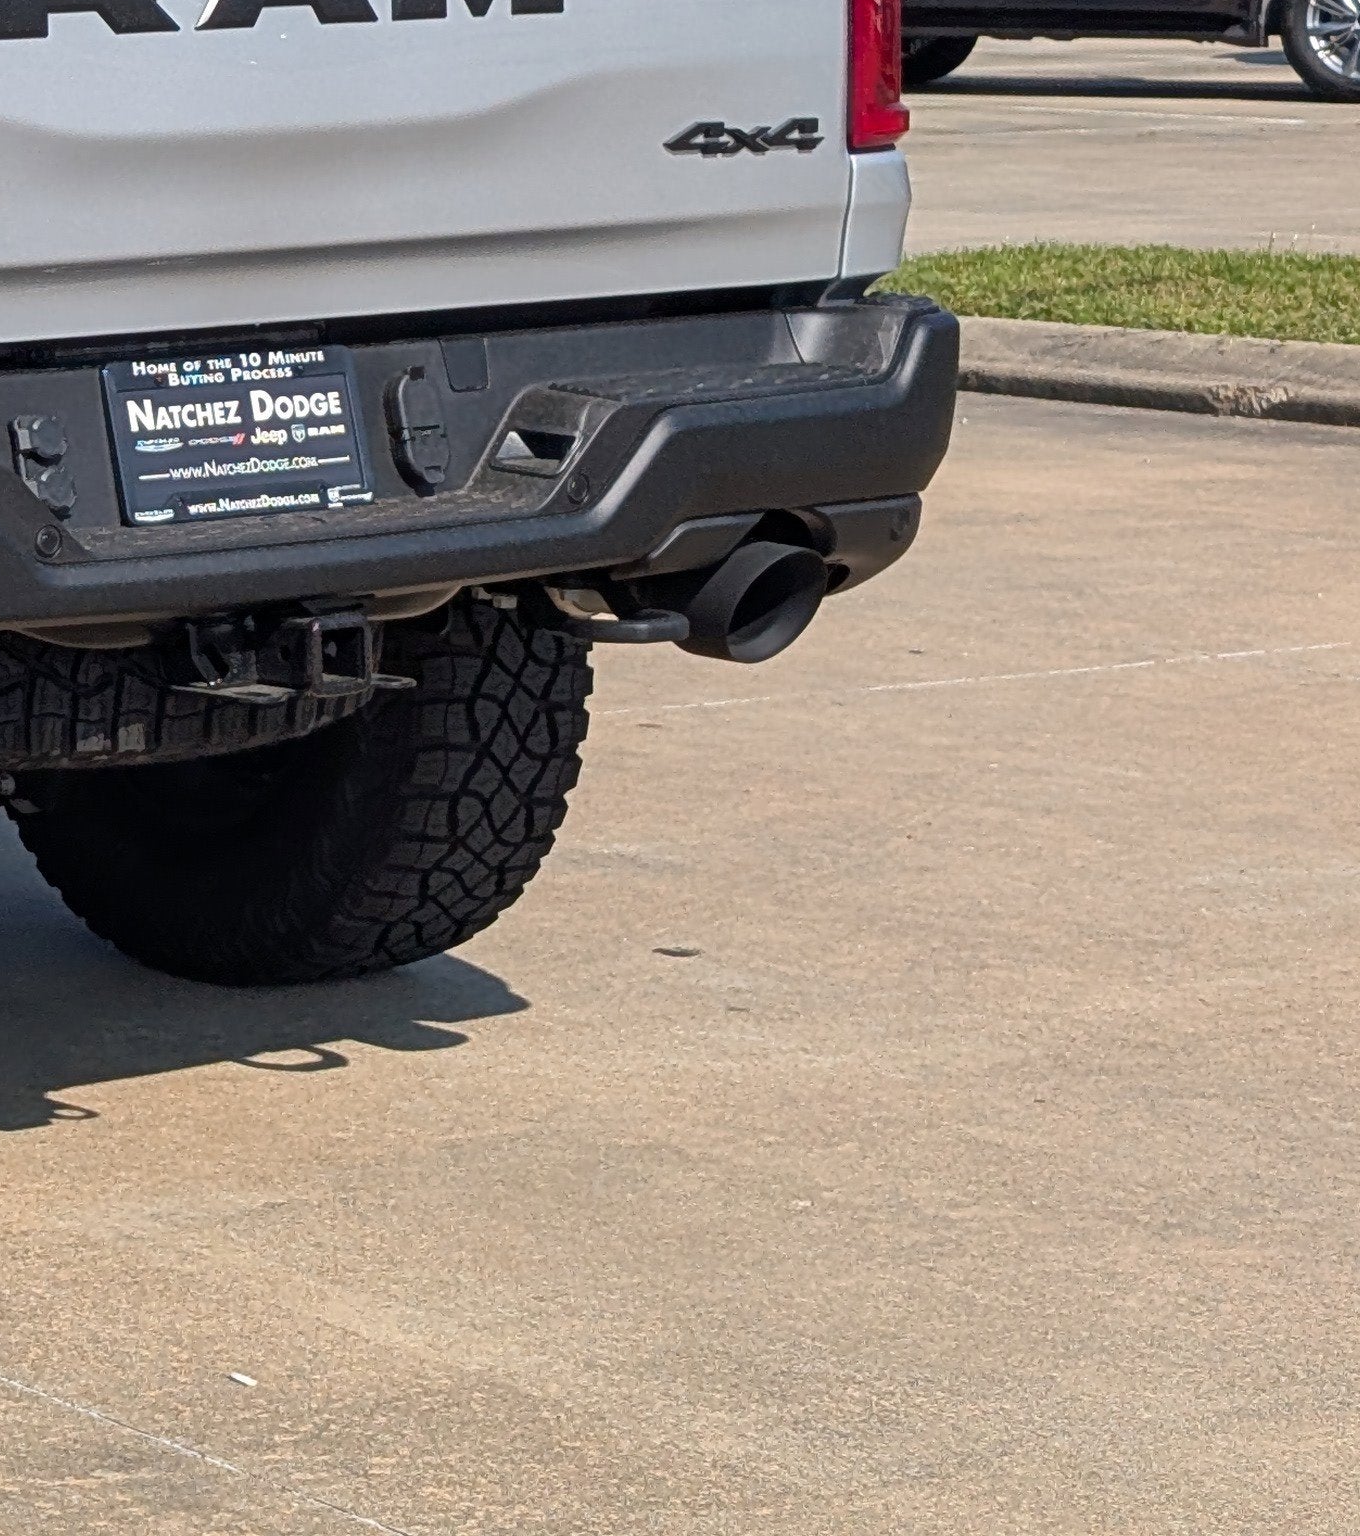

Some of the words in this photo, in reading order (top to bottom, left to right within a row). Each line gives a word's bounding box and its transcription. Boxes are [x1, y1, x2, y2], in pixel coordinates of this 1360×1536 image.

[663, 117, 825, 157] 4x4
[239, 352, 261, 367] 10
[250, 425, 288, 446] Jeep
